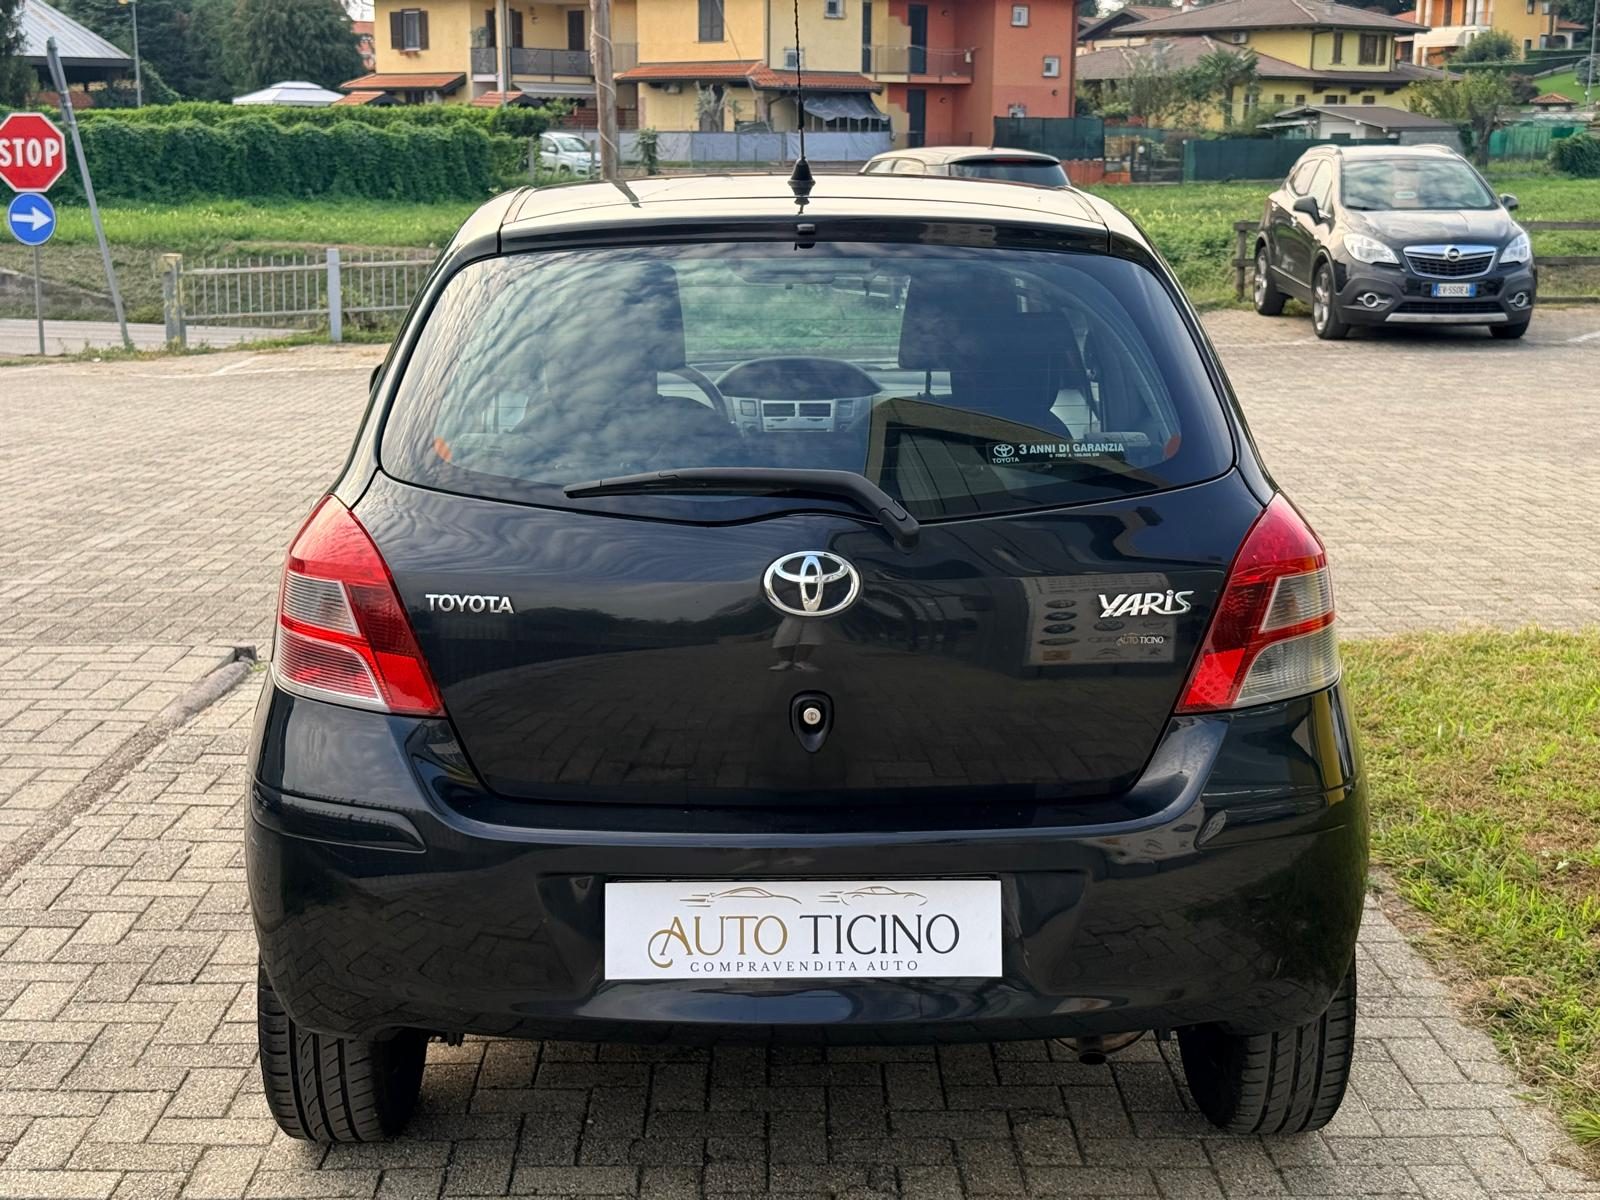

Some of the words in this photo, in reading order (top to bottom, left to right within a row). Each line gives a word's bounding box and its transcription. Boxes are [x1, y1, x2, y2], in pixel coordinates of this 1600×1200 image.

[0, 138, 60, 168] STOP
[1018, 443, 1027, 455] 3
[1029, 444, 1056, 454] ANNI
[1058, 443, 1070, 453] DI
[1073, 443, 1125, 453] GARANZIA
[425, 593, 514, 614] TOYOTA
[1139, 636, 1164, 645] TICINO
[648, 914, 788, 969] AUTO
[800, 913, 960, 955] TICINO
[690, 960, 859, 973] COMPRAVENDITA
[866, 959, 919, 972] AUTO
